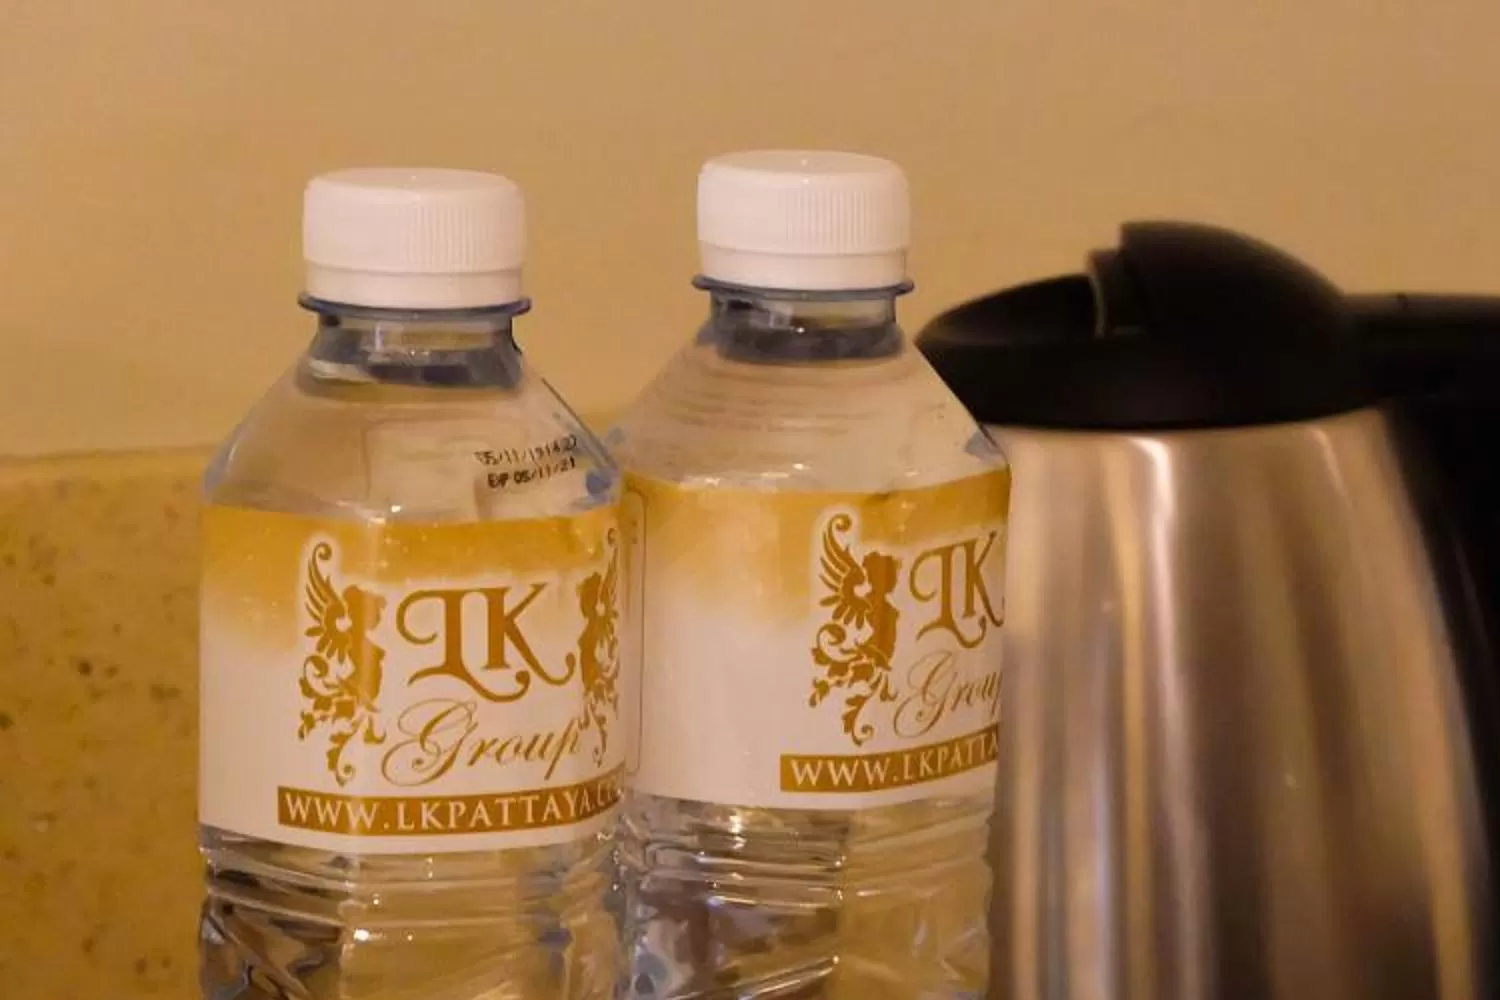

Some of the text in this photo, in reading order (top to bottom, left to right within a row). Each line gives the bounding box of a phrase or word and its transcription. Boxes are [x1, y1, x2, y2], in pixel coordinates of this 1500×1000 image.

[396, 582, 576, 703] LK
[909, 530, 1004, 649] LK
[381, 698, 580, 787] Group
